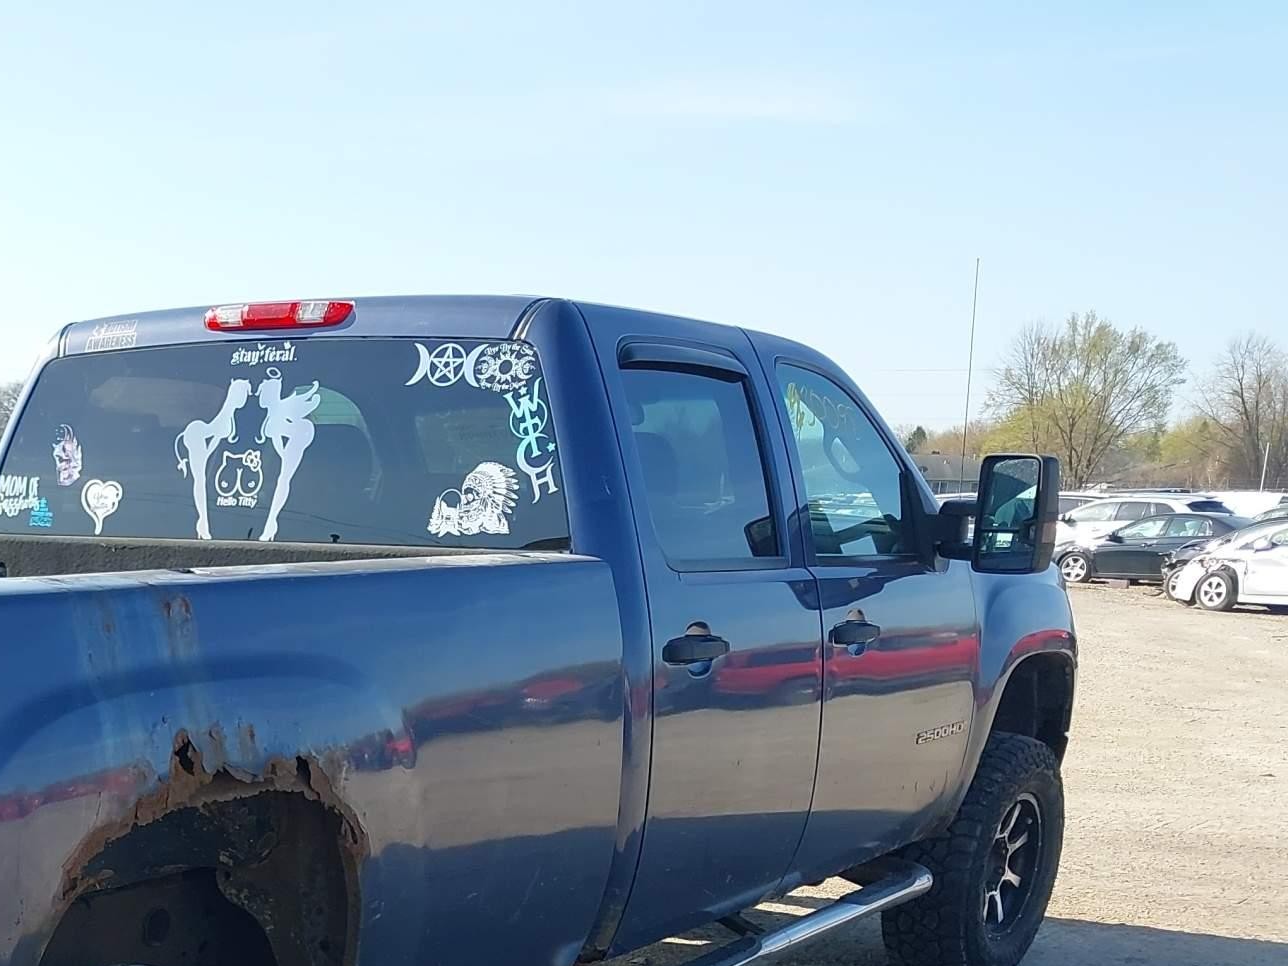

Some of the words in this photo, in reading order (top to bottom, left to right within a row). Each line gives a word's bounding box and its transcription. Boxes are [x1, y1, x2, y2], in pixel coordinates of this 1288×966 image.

[29, 476, 40, 498] OF
[217, 496, 237, 506] Hello
[238, 495, 258, 509] Titty
[915, 720, 965, 745] 2500HD
